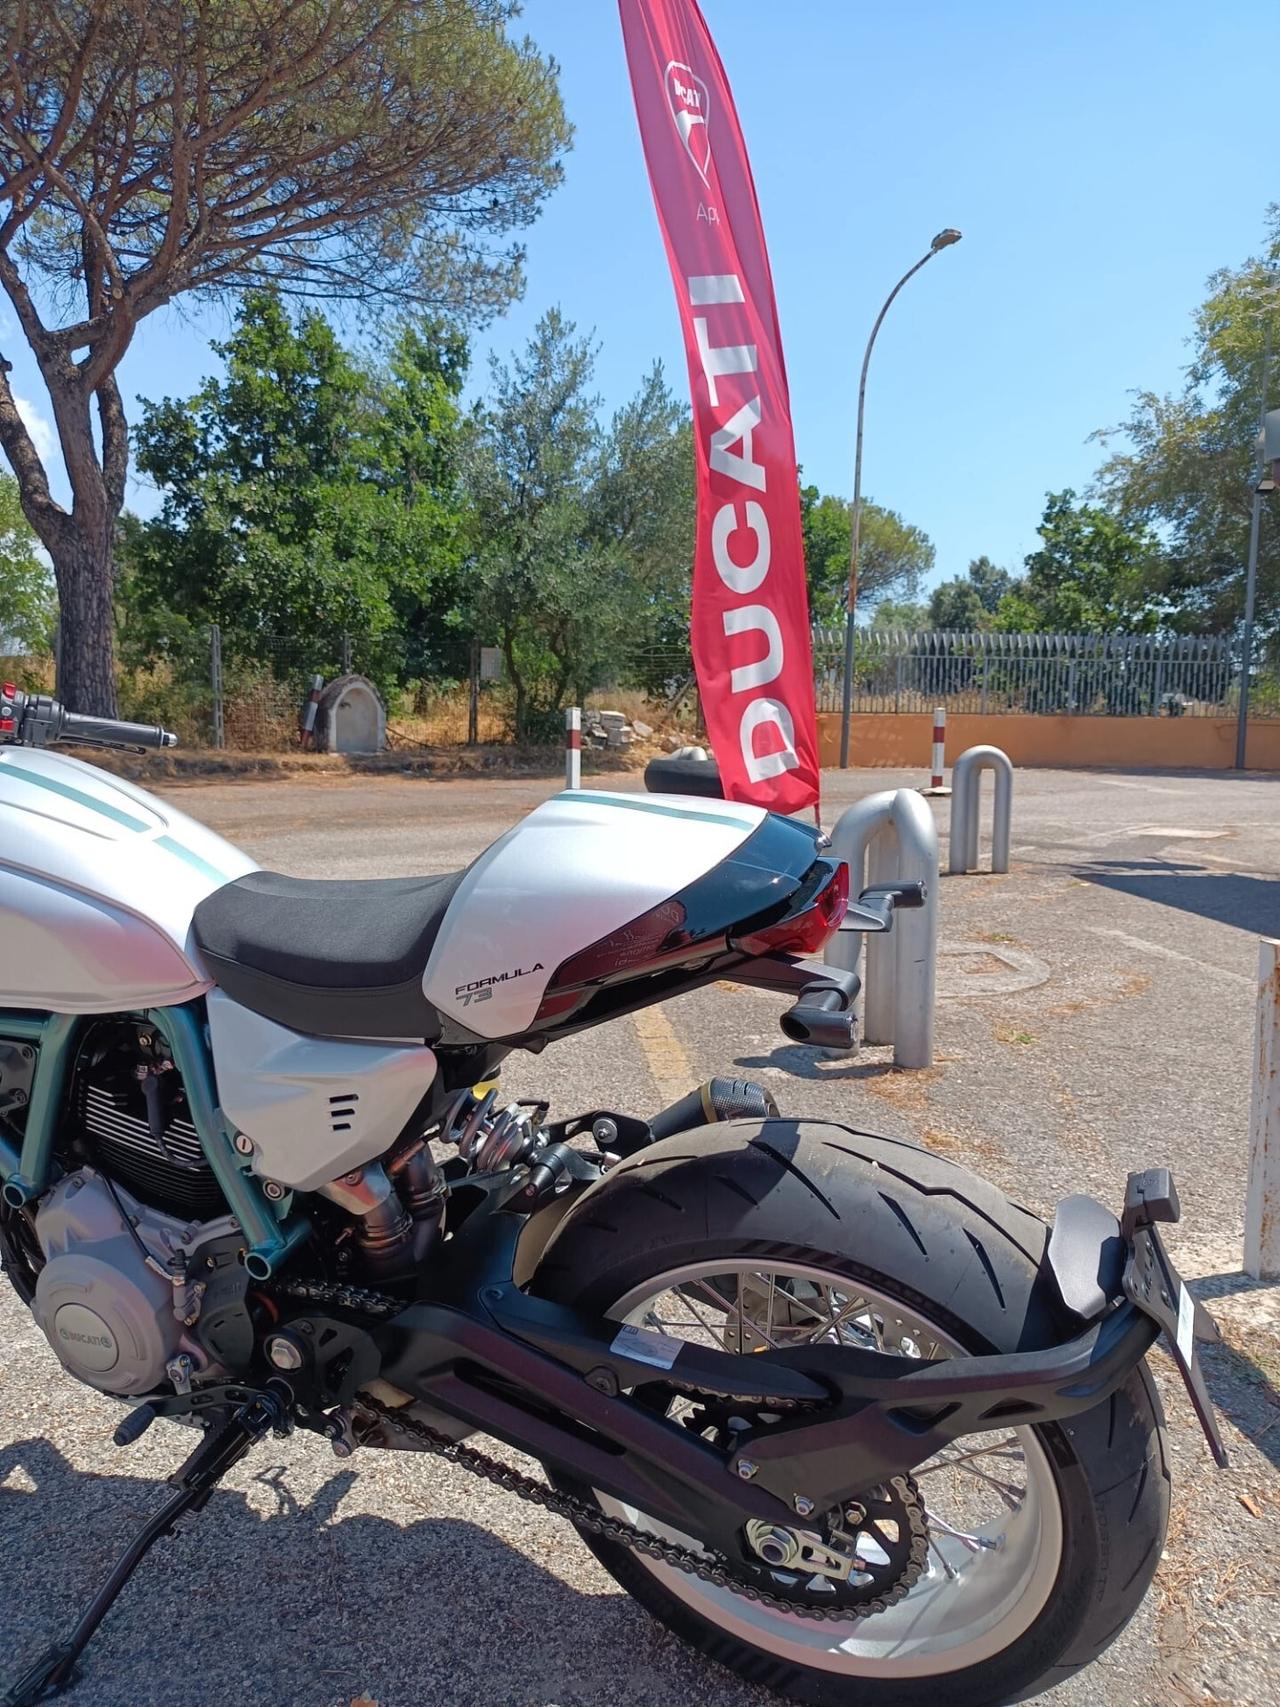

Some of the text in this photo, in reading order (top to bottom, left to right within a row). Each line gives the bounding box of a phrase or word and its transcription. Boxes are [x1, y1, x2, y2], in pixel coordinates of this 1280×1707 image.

[687, 274, 800, 784] DUCATI
[455, 963, 544, 995] FORMULA
[455, 988, 493, 1007] 73
